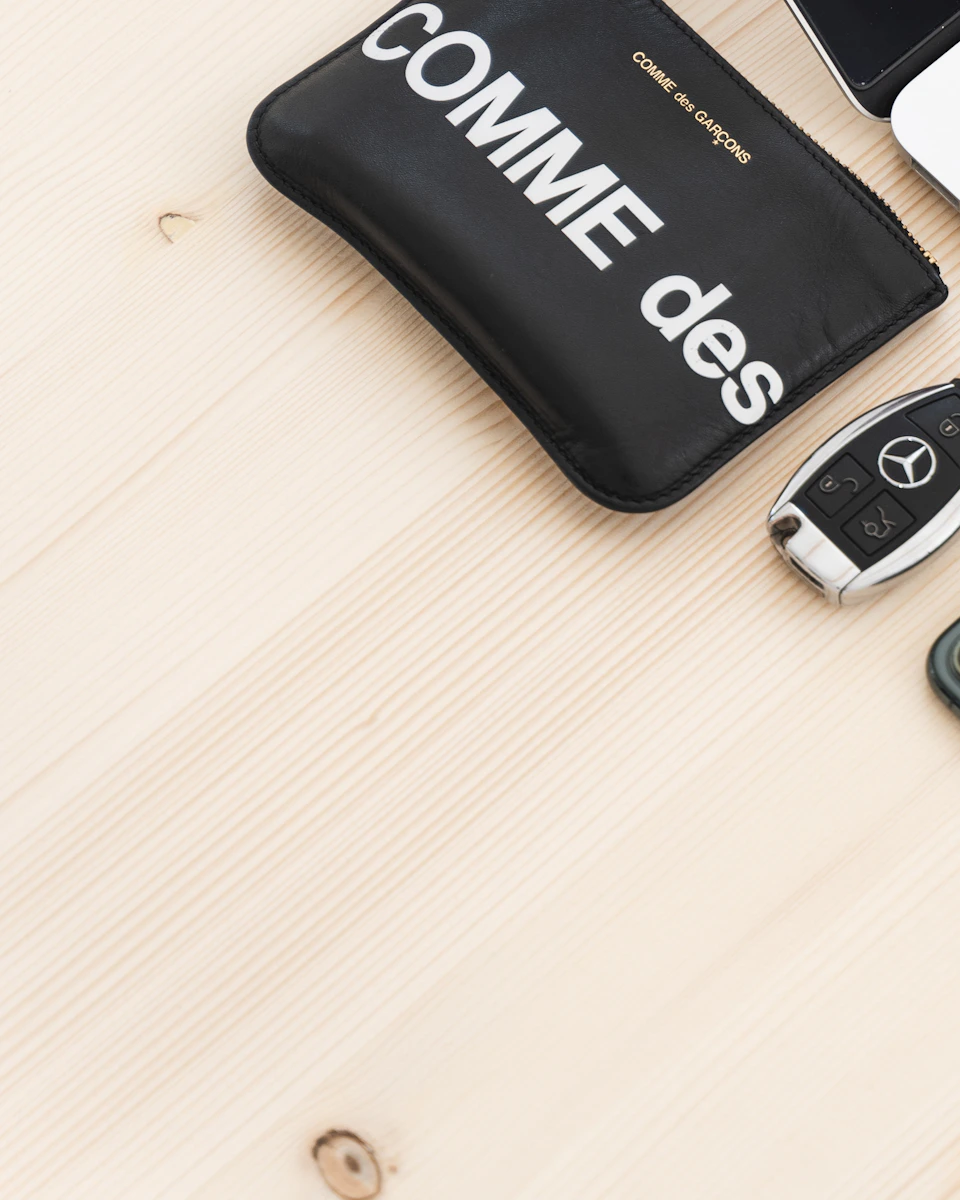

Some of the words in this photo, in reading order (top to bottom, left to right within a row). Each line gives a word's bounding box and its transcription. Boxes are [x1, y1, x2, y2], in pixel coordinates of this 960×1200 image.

[633, 52, 677, 92] COMME
[674, 93, 694, 112] des
[361, 3, 665, 271] COMME
[640, 274, 784, 426] des
